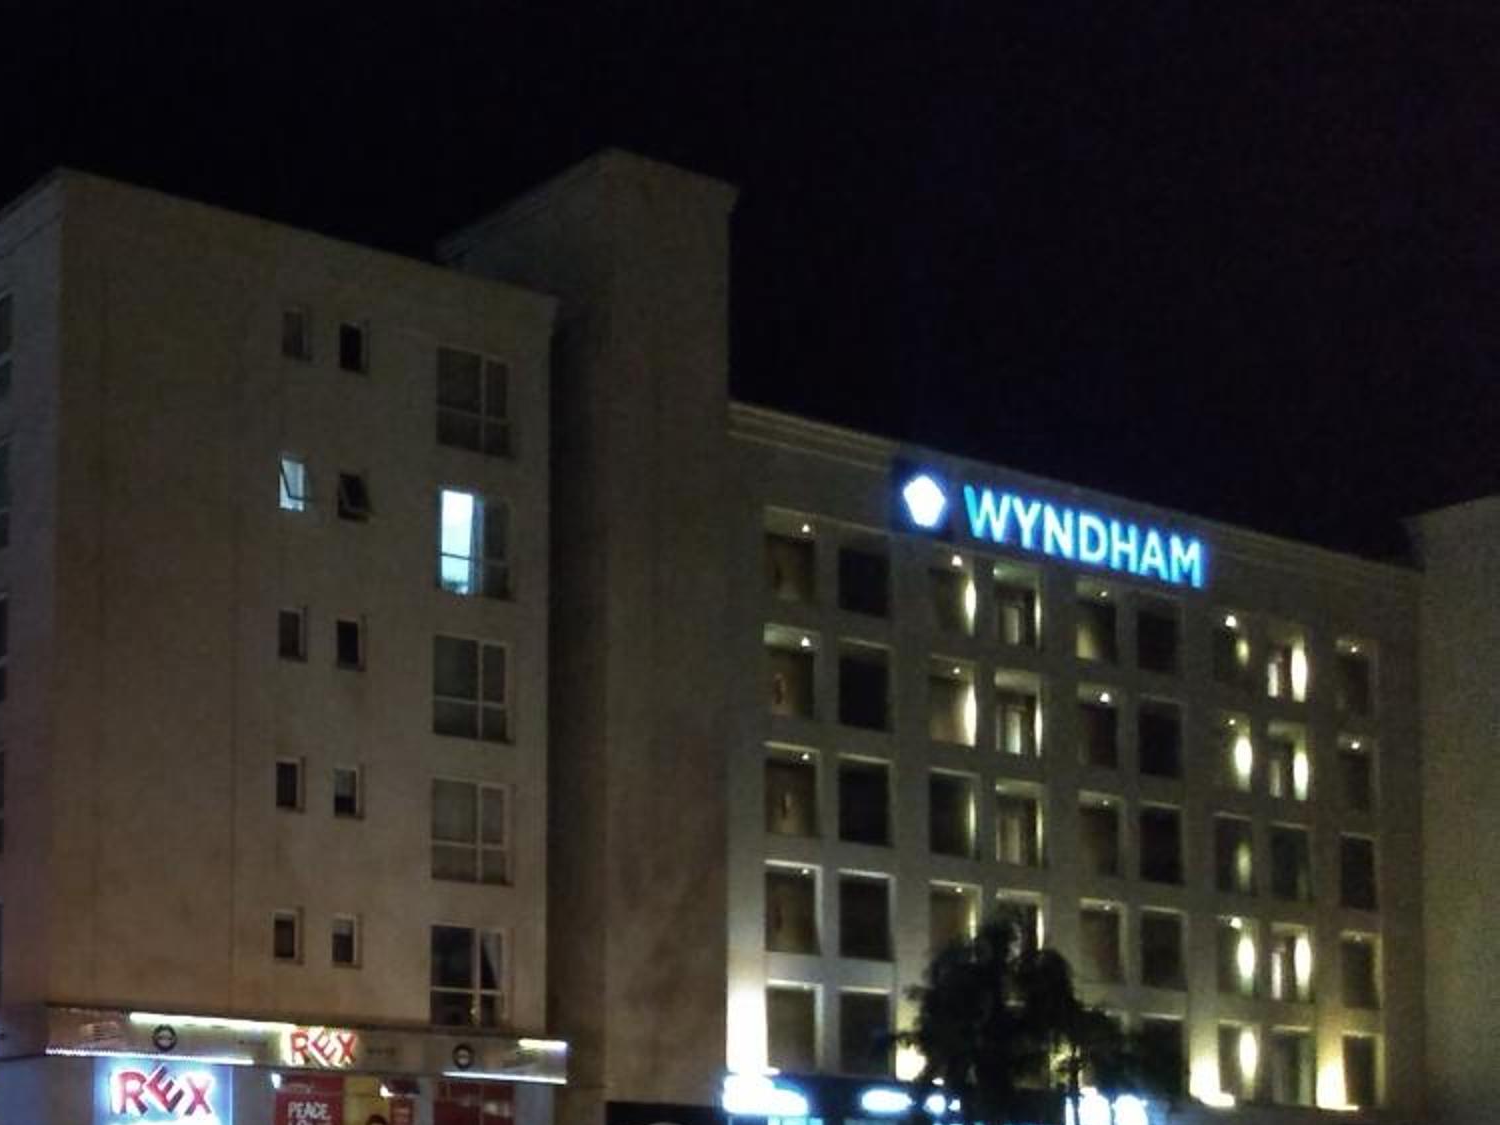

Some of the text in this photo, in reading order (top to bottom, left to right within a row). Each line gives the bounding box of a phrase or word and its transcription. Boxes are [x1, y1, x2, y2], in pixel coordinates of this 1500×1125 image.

[963, 484, 1202, 589] WYNDHAM
[289, 1028, 357, 1068] REX
[112, 1065, 213, 1117] REX
